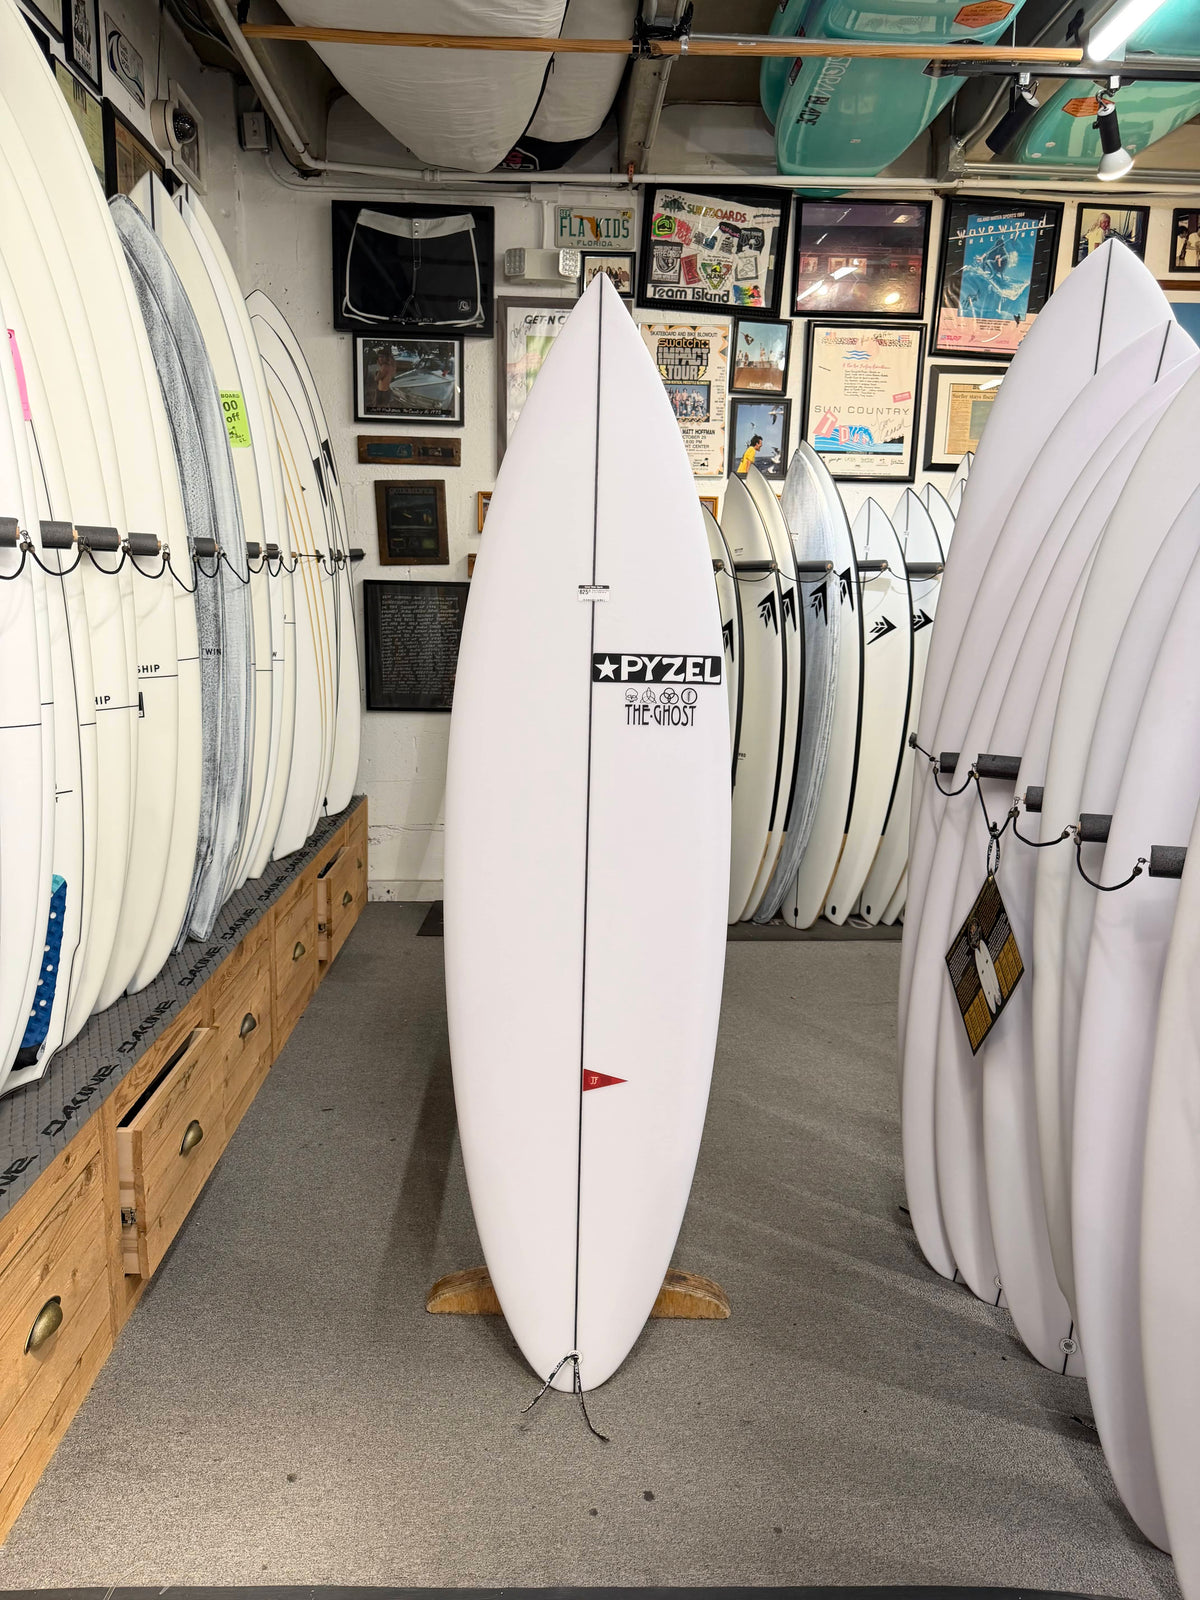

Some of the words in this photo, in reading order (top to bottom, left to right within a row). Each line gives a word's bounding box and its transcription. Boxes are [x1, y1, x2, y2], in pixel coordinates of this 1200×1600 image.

[596, 218, 630, 238] KIDS
[651, 285, 688, 298] Team
[691, 287, 731, 304] Island
[658, 338, 702, 348] swatch
[657, 346, 710, 366] IMPACT
[667, 365, 698, 380] TOUR
[814, 405, 841, 413] SUN
[847, 406, 910, 415] COUNTRY
[620, 654, 721, 683] PYZEL
[221, 907, 258, 941] DAKINE
[178, 945, 225, 987] DAKINE
[117, 1000, 177, 1054] DAKINE
[41, 1063, 119, 1137] DAKINE
